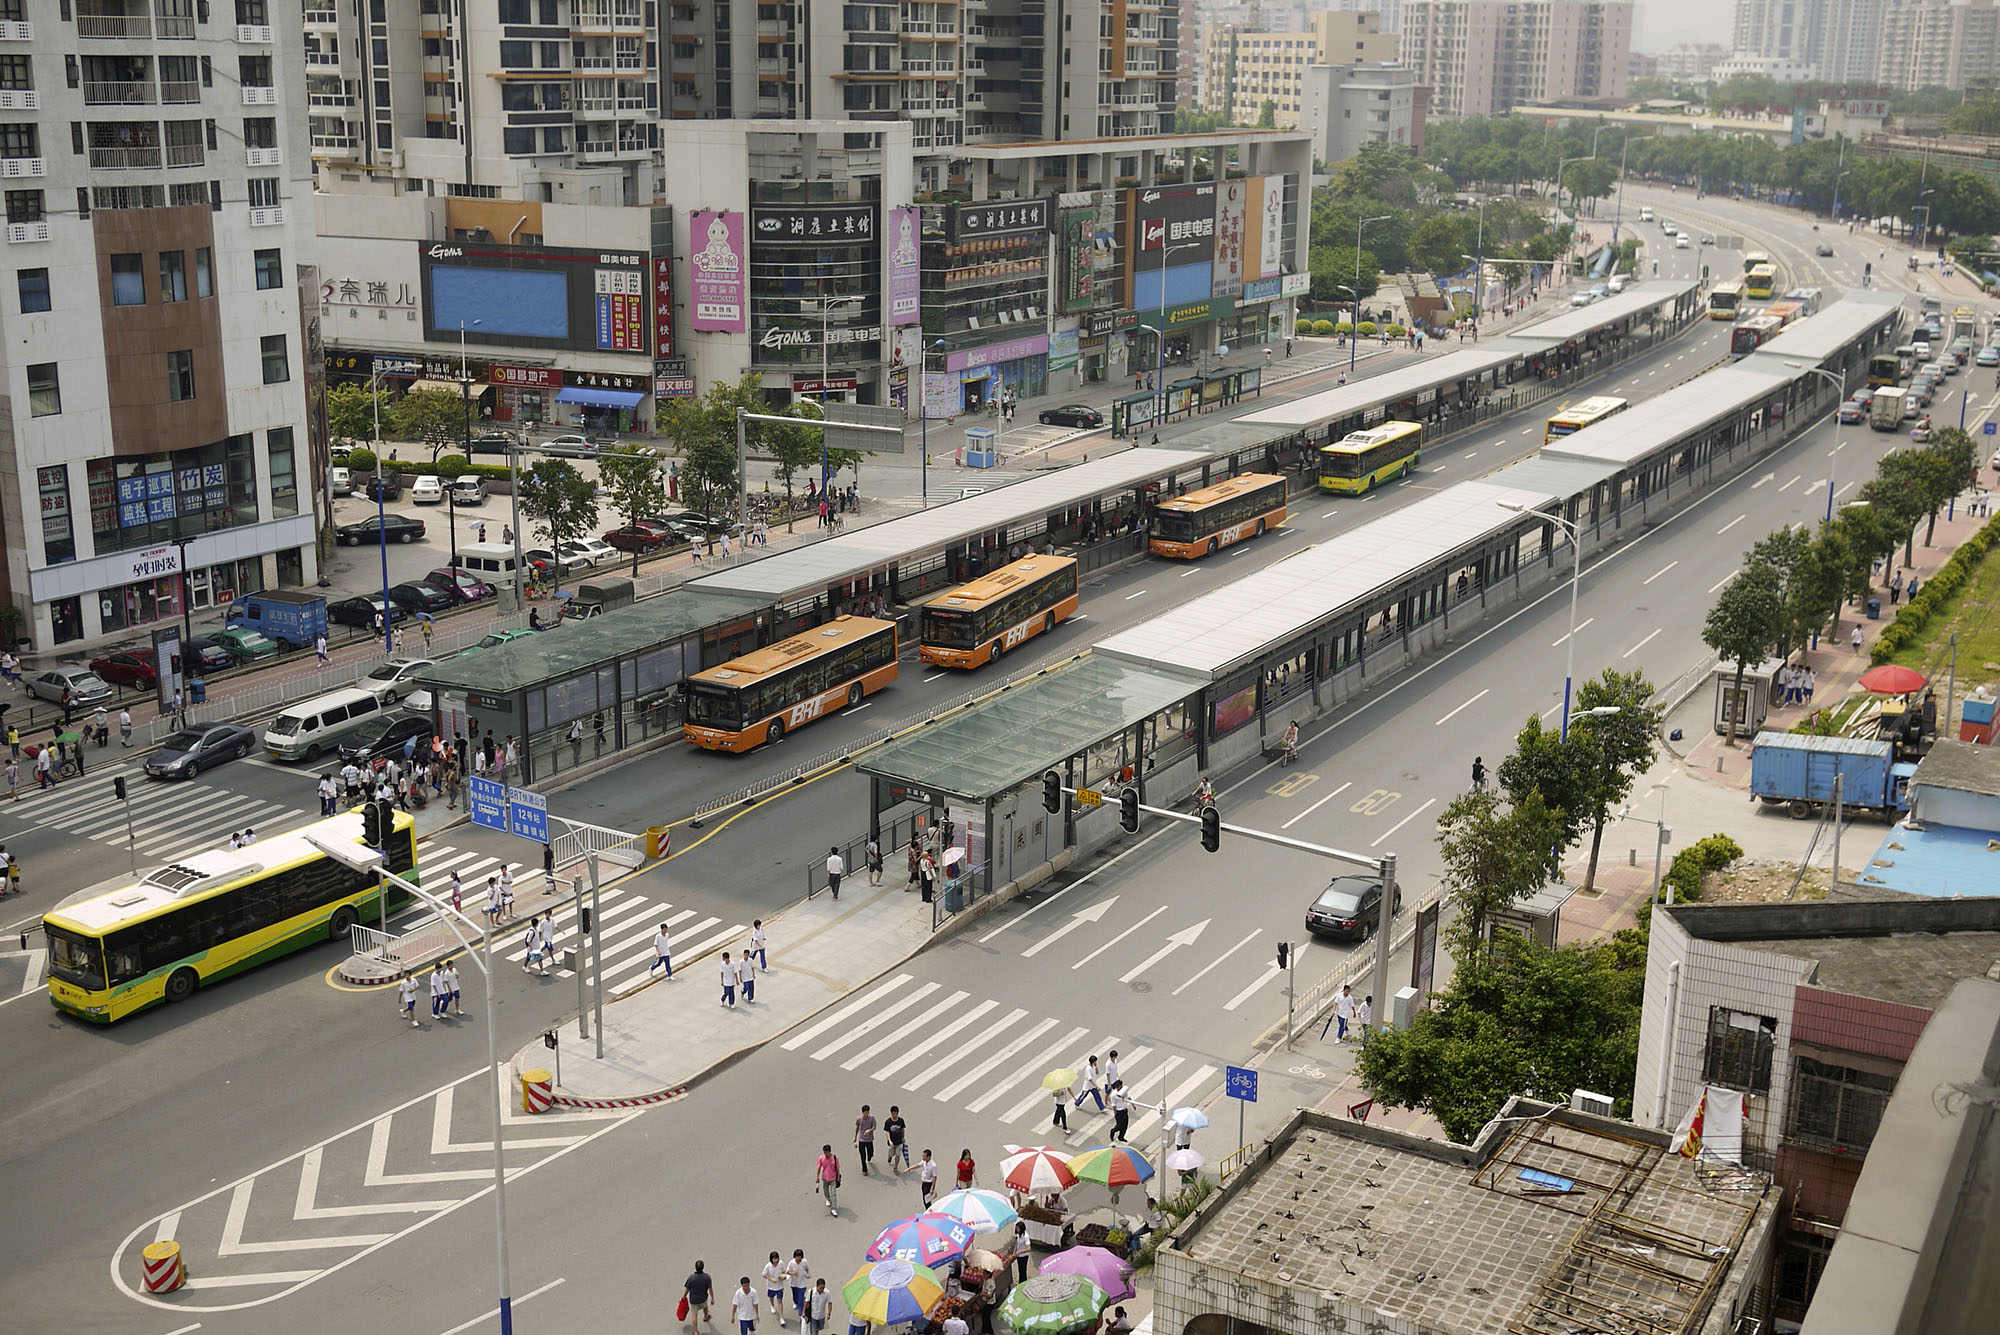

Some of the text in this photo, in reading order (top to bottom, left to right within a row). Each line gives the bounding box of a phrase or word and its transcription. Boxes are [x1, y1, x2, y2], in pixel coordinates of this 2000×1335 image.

[790, 215, 870, 235] 洞庭土菜馆
[1170, 218, 1213, 240] 国美电器
[600, 254, 640, 265] 国美电器
[339, 277, 416, 306] 奈瑞儿
[827, 327, 881, 343] 国美电器
[506, 368, 549, 382] 国昌地产
[40, 470, 63, 486] 监控
[181, 464, 225, 490] 竹炭
[42, 496, 65, 512] 防盗
[124, 498, 174, 521] 监控工程
[1221, 523, 1243, 546] BRT
[133, 556, 177, 577] 孕妇时装
[1005, 620, 1032, 649] BRT
[789, 693, 827, 727] BRT
[478, 782, 496, 794] BRT
[1264, 772, 1320, 798] 60
[1349, 789, 1402, 816] 60
[518, 808, 540, 824] 12号站
[950, 1225, 967, 1245] EF
